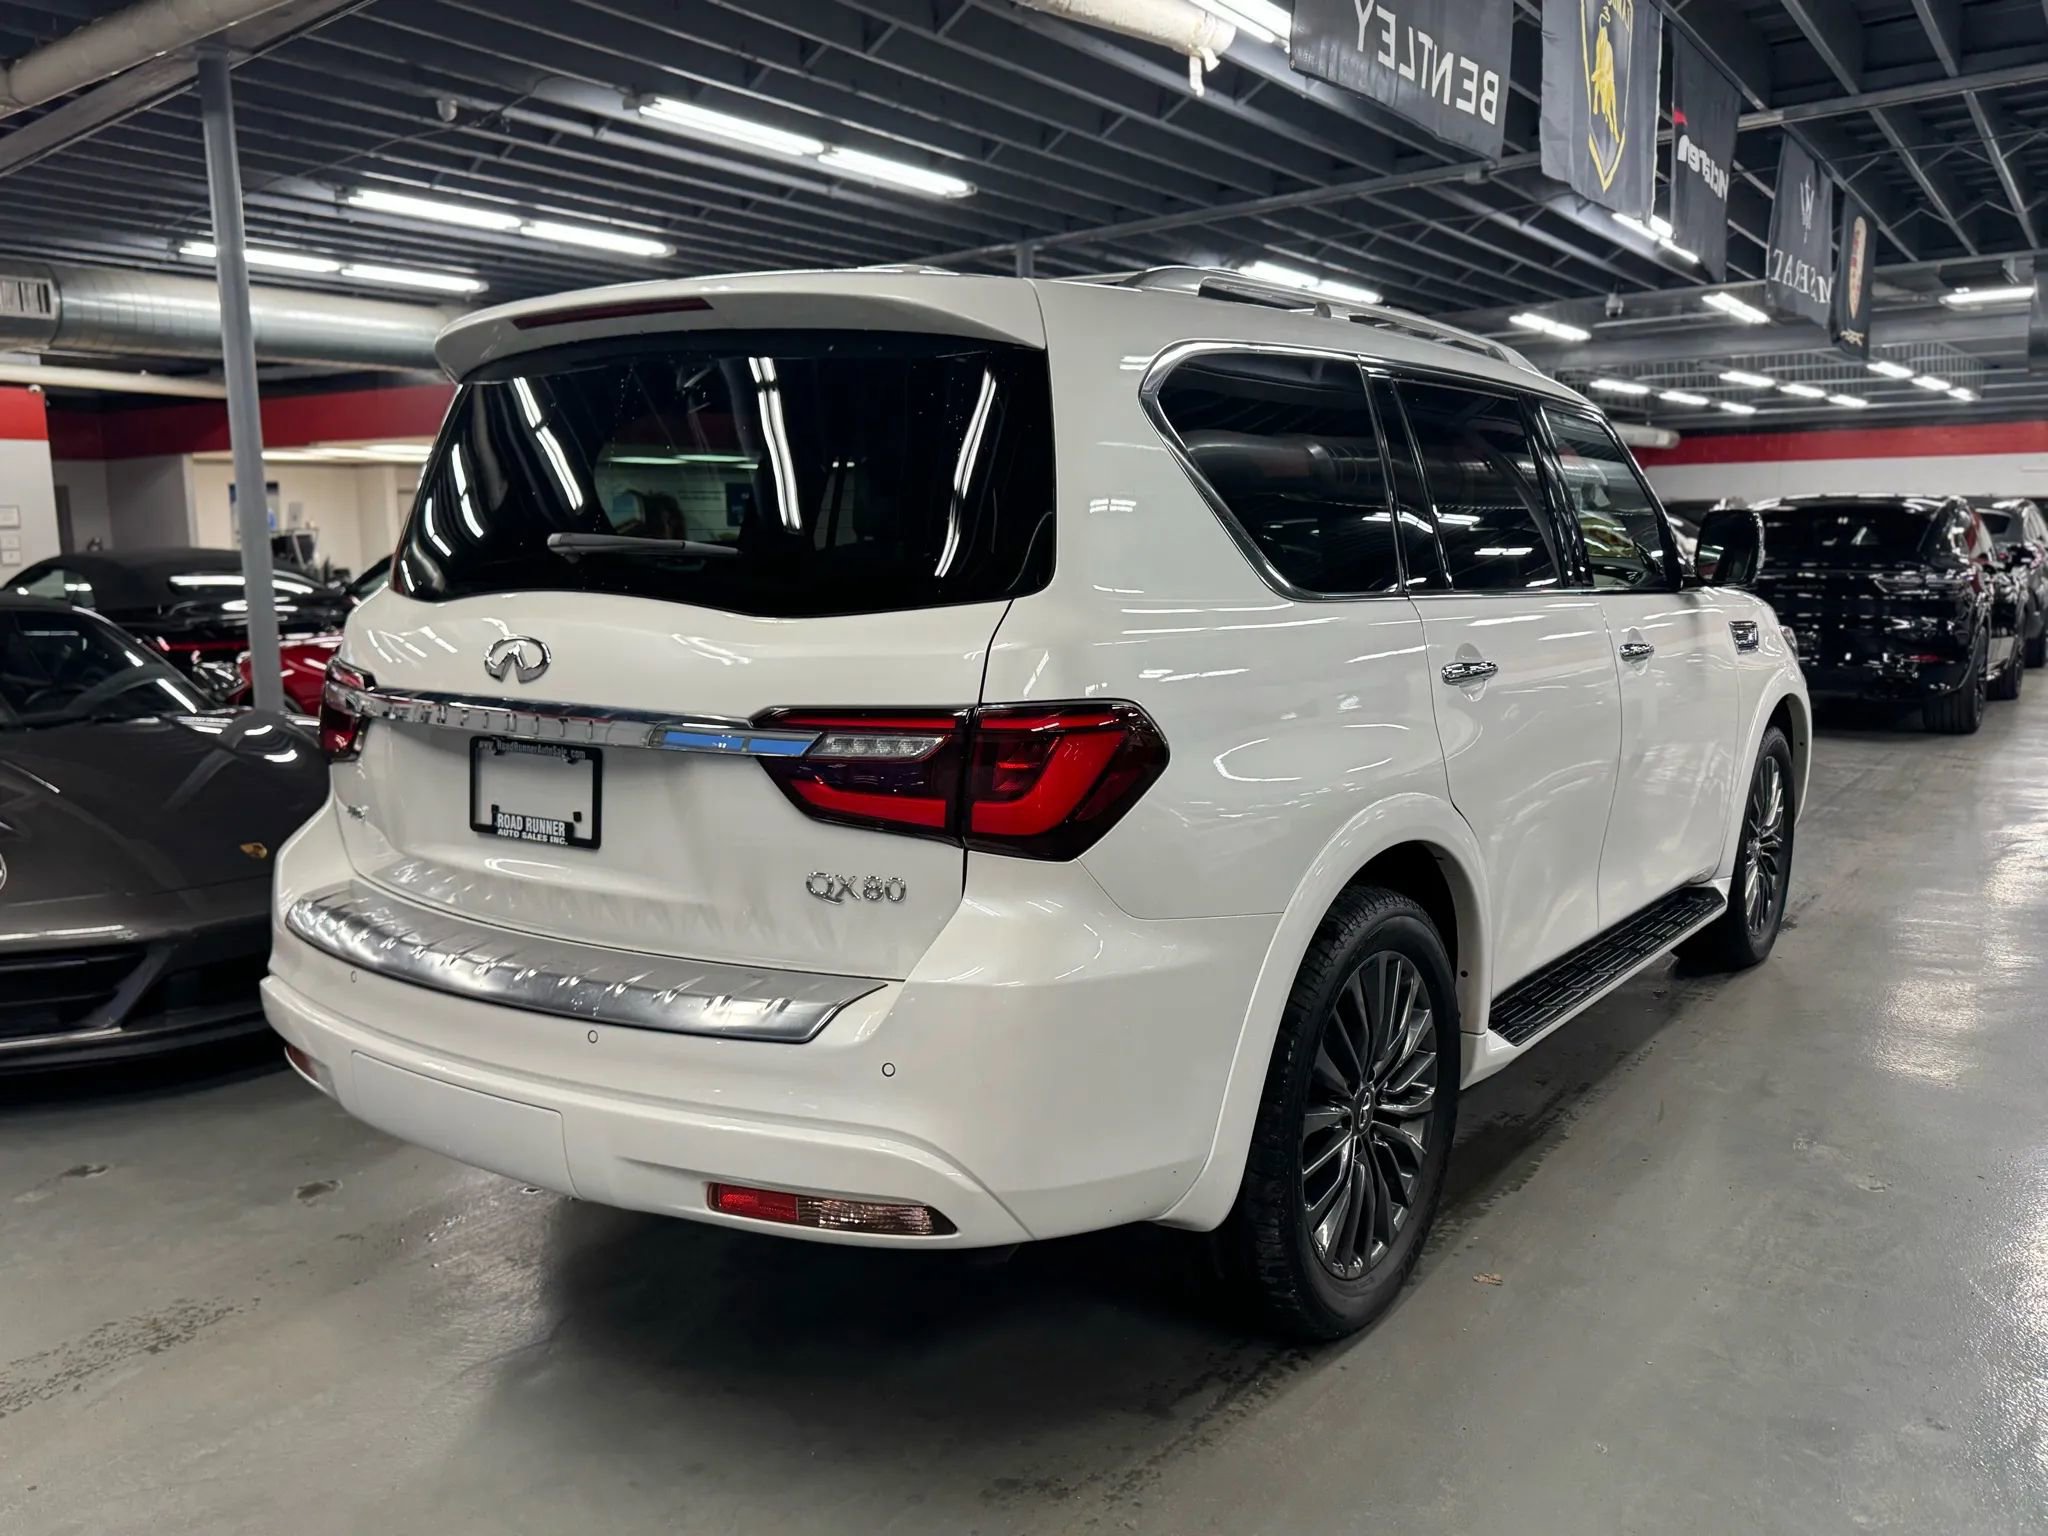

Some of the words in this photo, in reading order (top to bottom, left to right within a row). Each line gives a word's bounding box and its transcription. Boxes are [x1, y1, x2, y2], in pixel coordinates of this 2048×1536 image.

[497, 813, 523, 831] ROAD
[525, 818, 566, 837] RUNNER
[497, 828, 520, 838] AUTO
[522, 832, 548, 842] SALES
[550, 835, 569, 845] INC.
[806, 871, 906, 905] QX80
